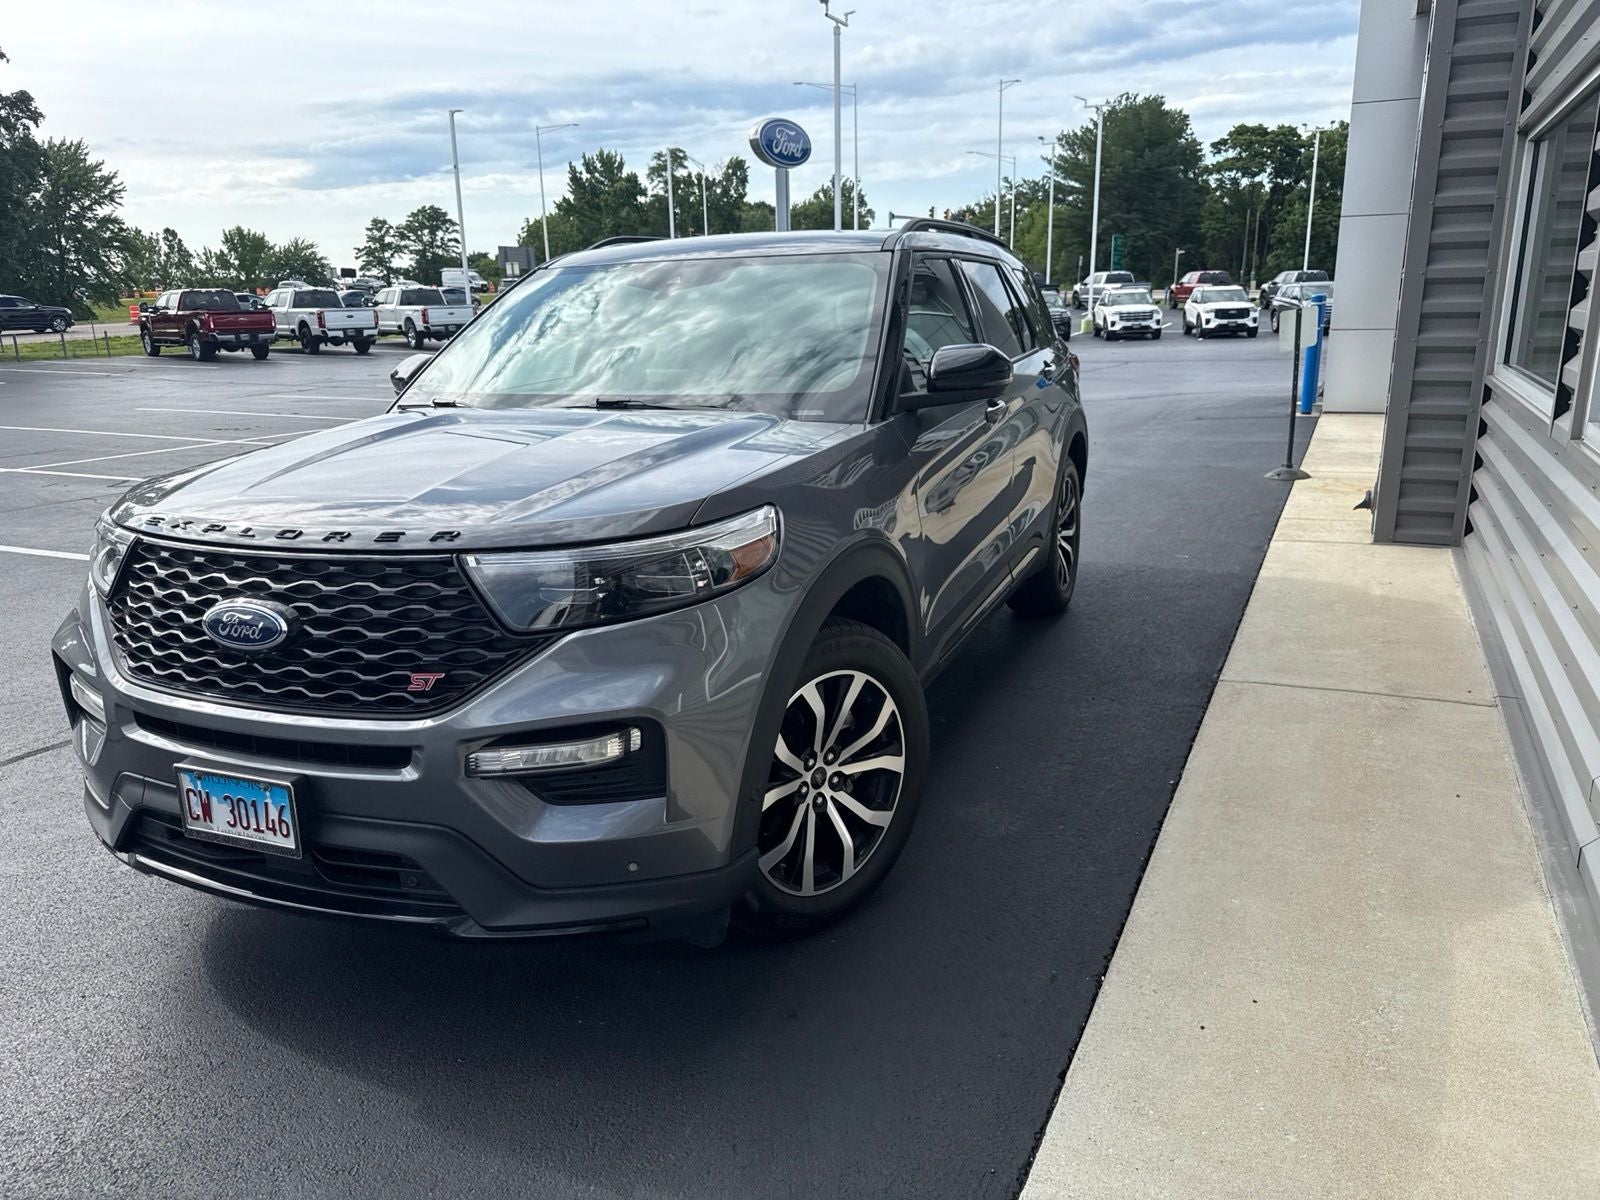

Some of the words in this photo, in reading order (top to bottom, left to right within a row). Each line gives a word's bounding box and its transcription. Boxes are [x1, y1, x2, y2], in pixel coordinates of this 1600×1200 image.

[772, 127, 803, 158] Ford
[145, 516, 461, 542] EXPLORER
[218, 611, 263, 640] Ford
[408, 672, 445, 691] ST
[186, 788, 213, 823] CW
[223, 794, 291, 838] 30146
